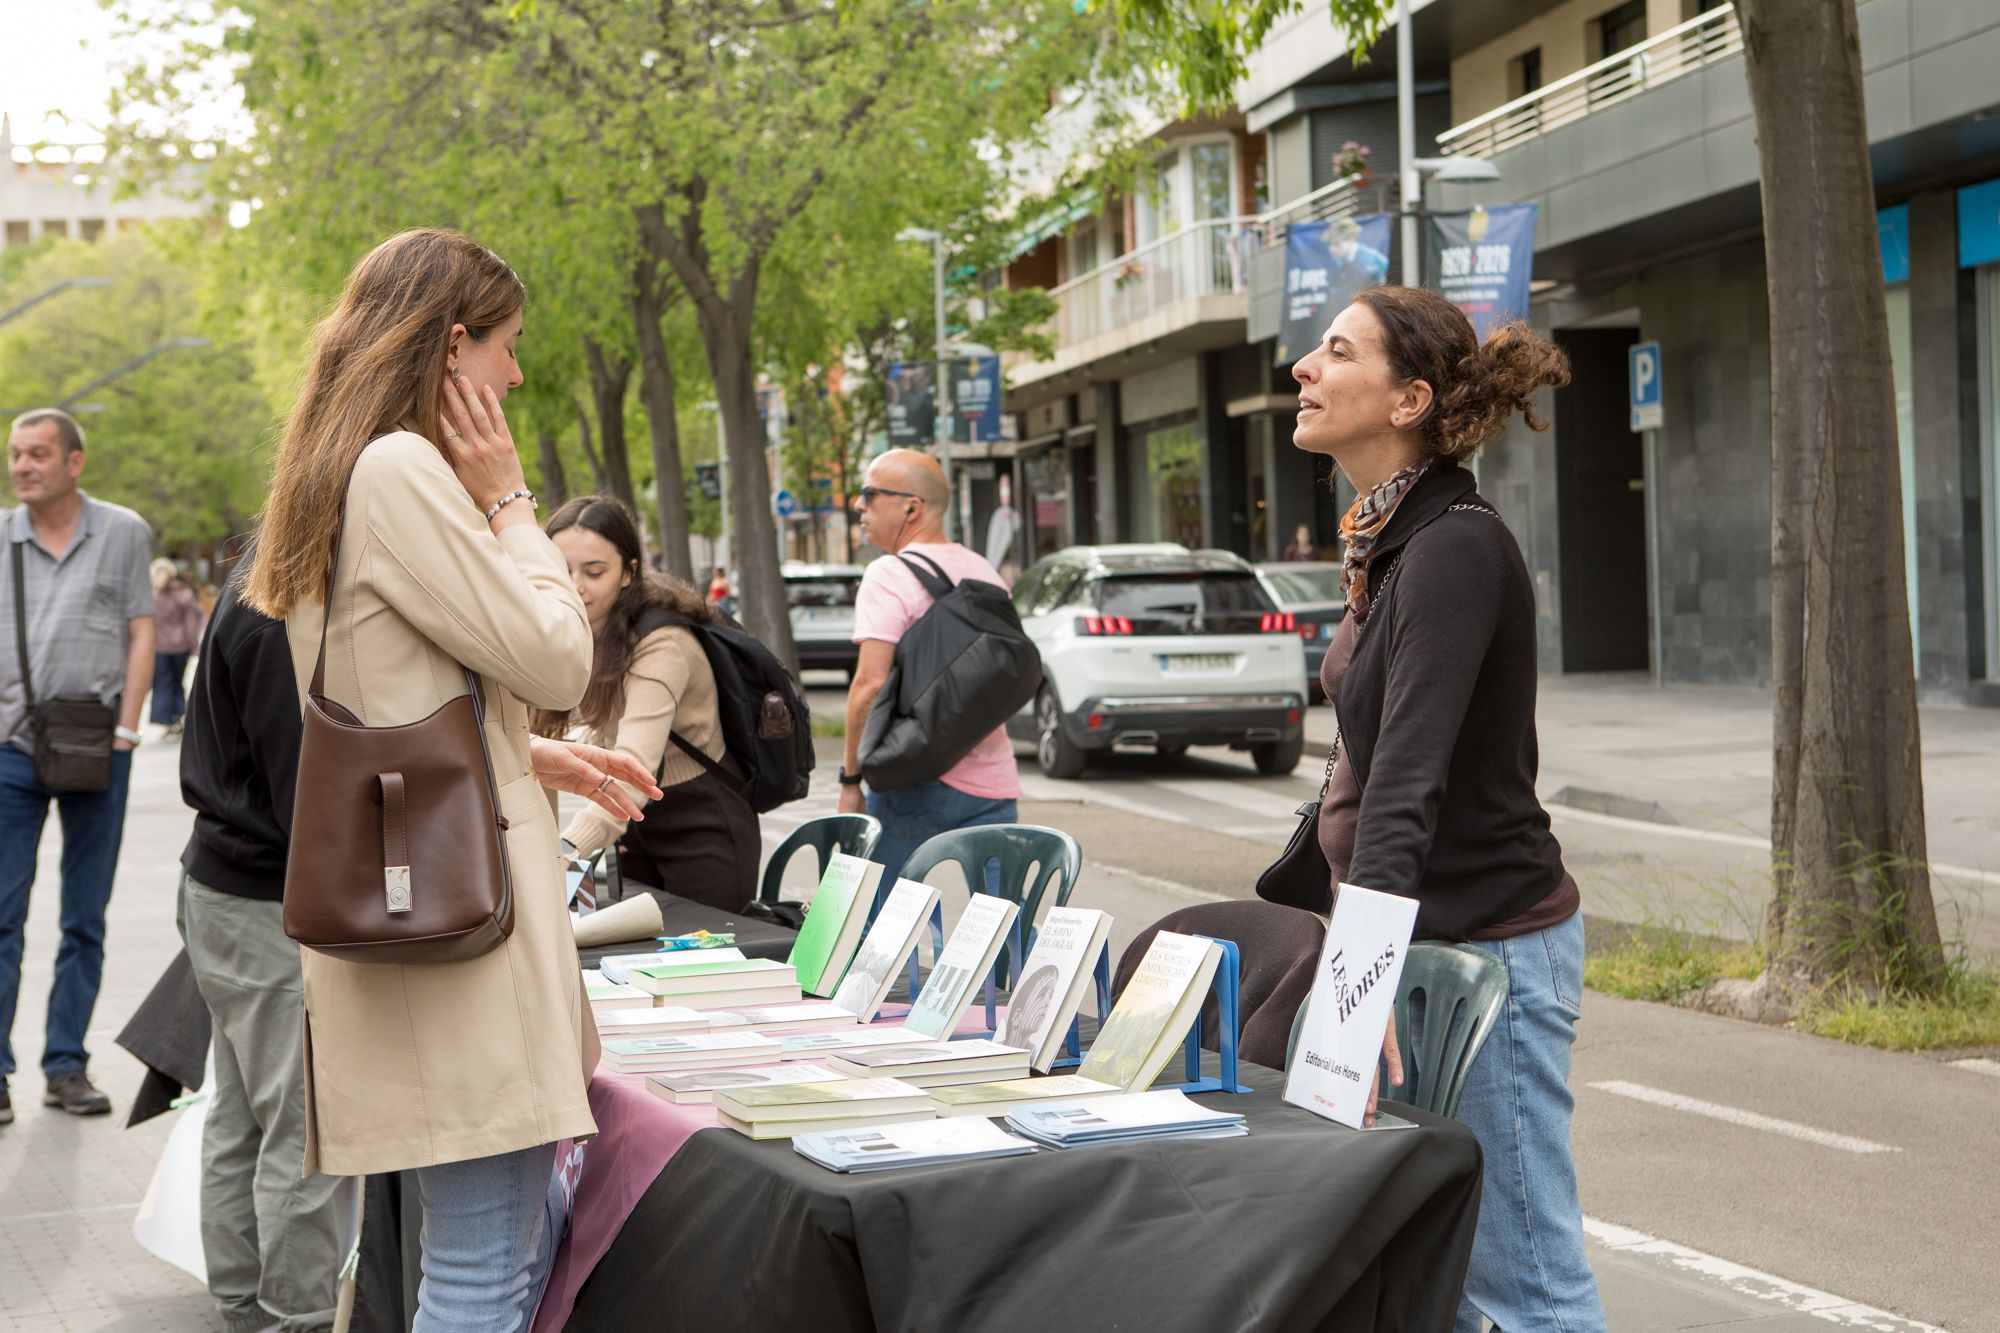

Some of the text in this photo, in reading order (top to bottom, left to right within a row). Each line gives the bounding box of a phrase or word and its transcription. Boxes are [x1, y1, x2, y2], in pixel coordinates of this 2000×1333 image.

[1635, 351, 1655, 401] P
[1331, 947, 1349, 1004] LES
[1338, 942, 1395, 1026] HORES
[1306, 1051, 1360, 1082] Editorial Les Hores
